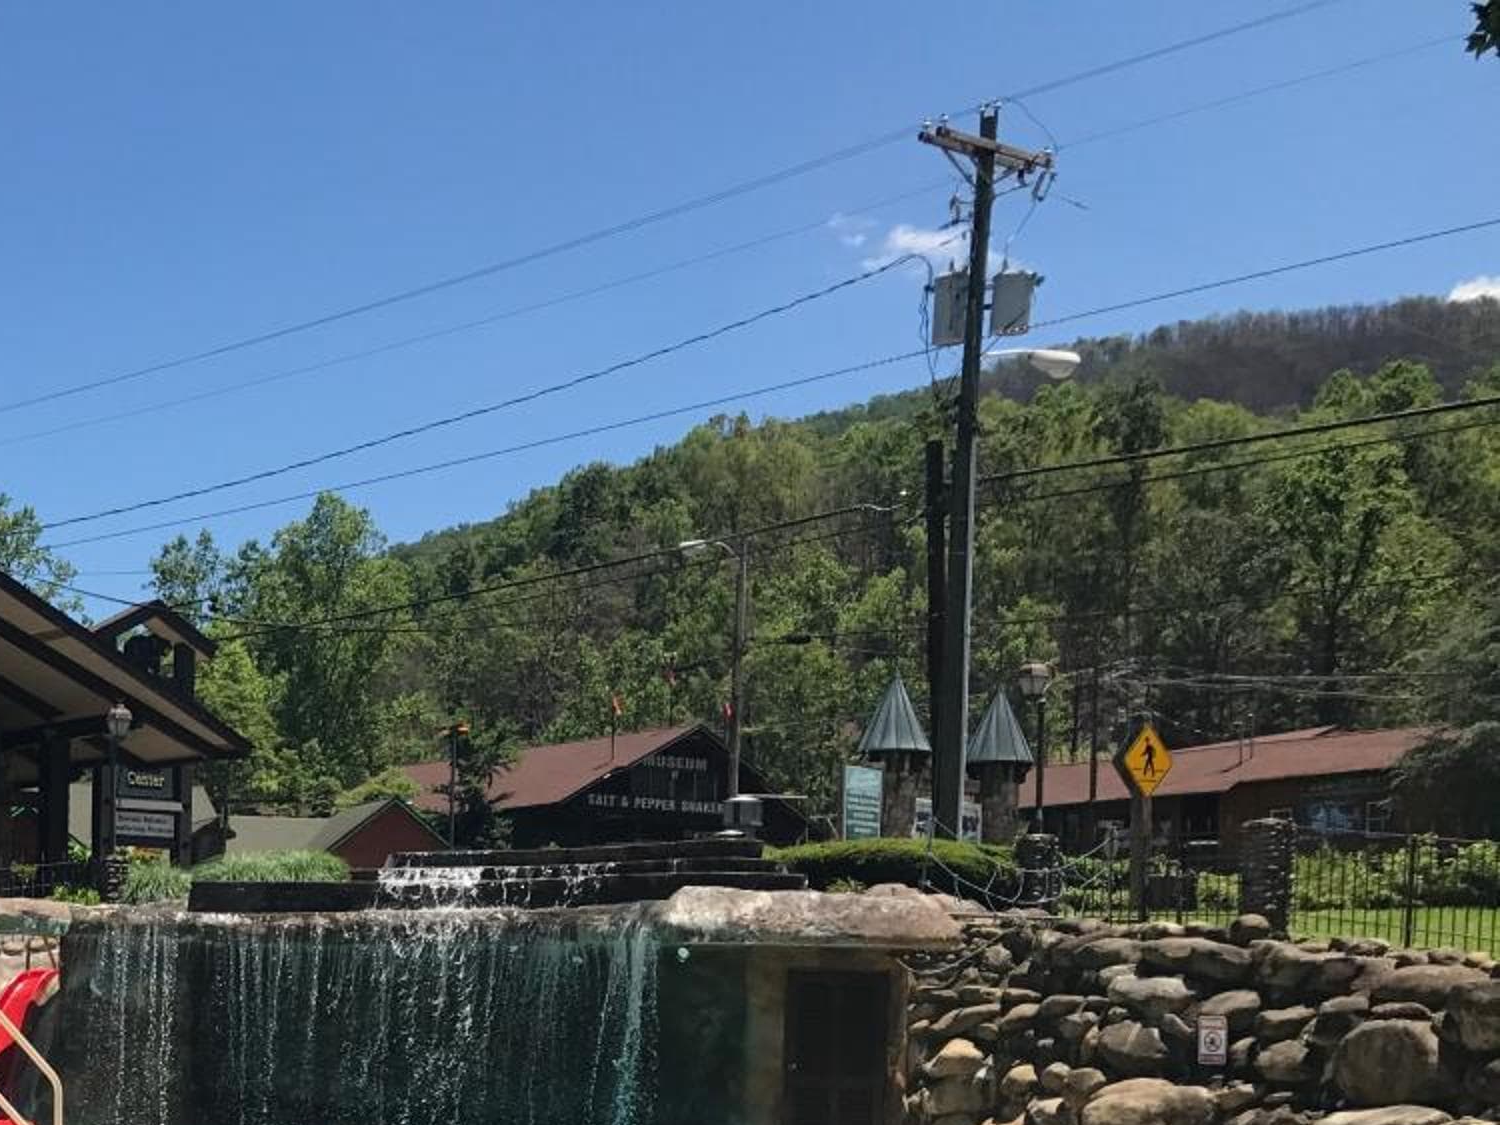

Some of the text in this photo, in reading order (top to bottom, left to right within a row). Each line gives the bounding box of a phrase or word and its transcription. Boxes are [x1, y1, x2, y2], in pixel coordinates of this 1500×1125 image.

[644, 754, 708, 771] MUSEUM
[127, 771, 164, 787] Center
[588, 793, 615, 807] SALT
[633, 797, 676, 812] PEPPER
[681, 800, 725, 815] SHAKER
